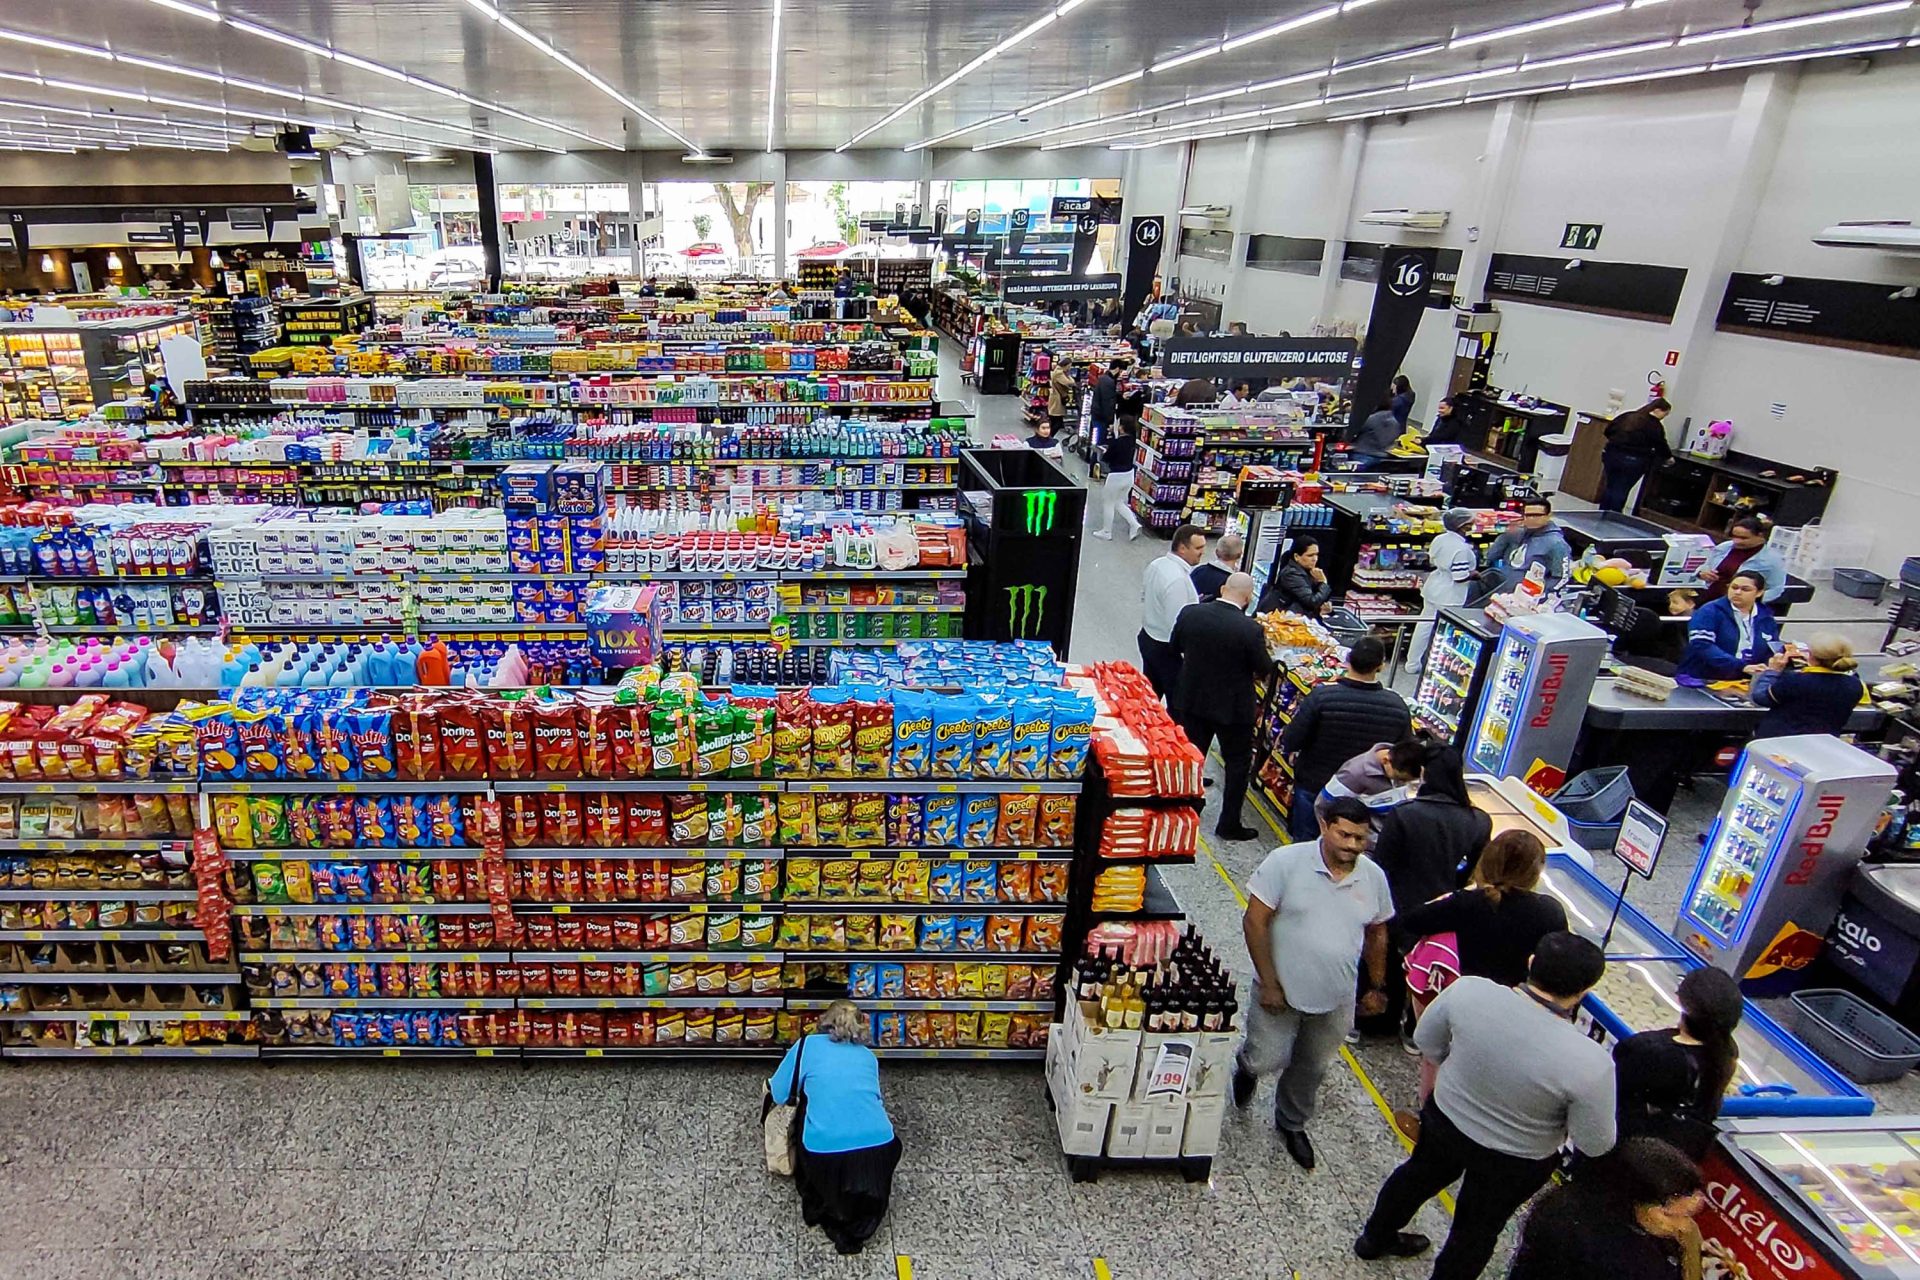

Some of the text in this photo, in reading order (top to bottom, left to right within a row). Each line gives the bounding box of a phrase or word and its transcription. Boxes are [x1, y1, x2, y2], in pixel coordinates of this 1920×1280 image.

[1083, 219, 1095, 230] 12
[1142, 226, 1157, 240] 14
[1397, 263, 1419, 287] 16
[1170, 351, 1348, 364] DIET/LIGHT/SEM GLUTEN/ZERO LACTOSE
[265, 535, 278, 543] OMO
[295, 535, 308, 543] OMO
[325, 535, 339, 543] OMO
[361, 531, 376, 539] OMO
[389, 534, 404, 542] OMO
[421, 535, 437, 543] OMO
[452, 534, 468, 542] OMO
[483, 534, 499, 542] OMO
[268, 557, 282, 565] OMO
[299, 557, 313, 565] OMO
[330, 557, 344, 565] OMO
[360, 556, 375, 565] OMO
[391, 556, 407, 565] OMO
[424, 557, 439, 565] OMO
[455, 557, 470, 565] OMO
[486, 557, 501, 565] OMO
[366, 585, 381, 593] OMO
[428, 586, 443, 594] OMO
[459, 586, 474, 594] OMO
[489, 585, 504, 594] OMO
[150, 600, 168, 609] OMO
[369, 607, 383, 615] OMO
[430, 607, 446, 615] OMO
[461, 607, 476, 615] OMO
[491, 607, 507, 615] OMO
[596, 629, 639, 648] 10X
[441, 727, 475, 737] Doritos
[535, 727, 572, 737] Doritos
[1014, 719, 1050, 740] Cheetos
[630, 807, 662, 817] Doritos
